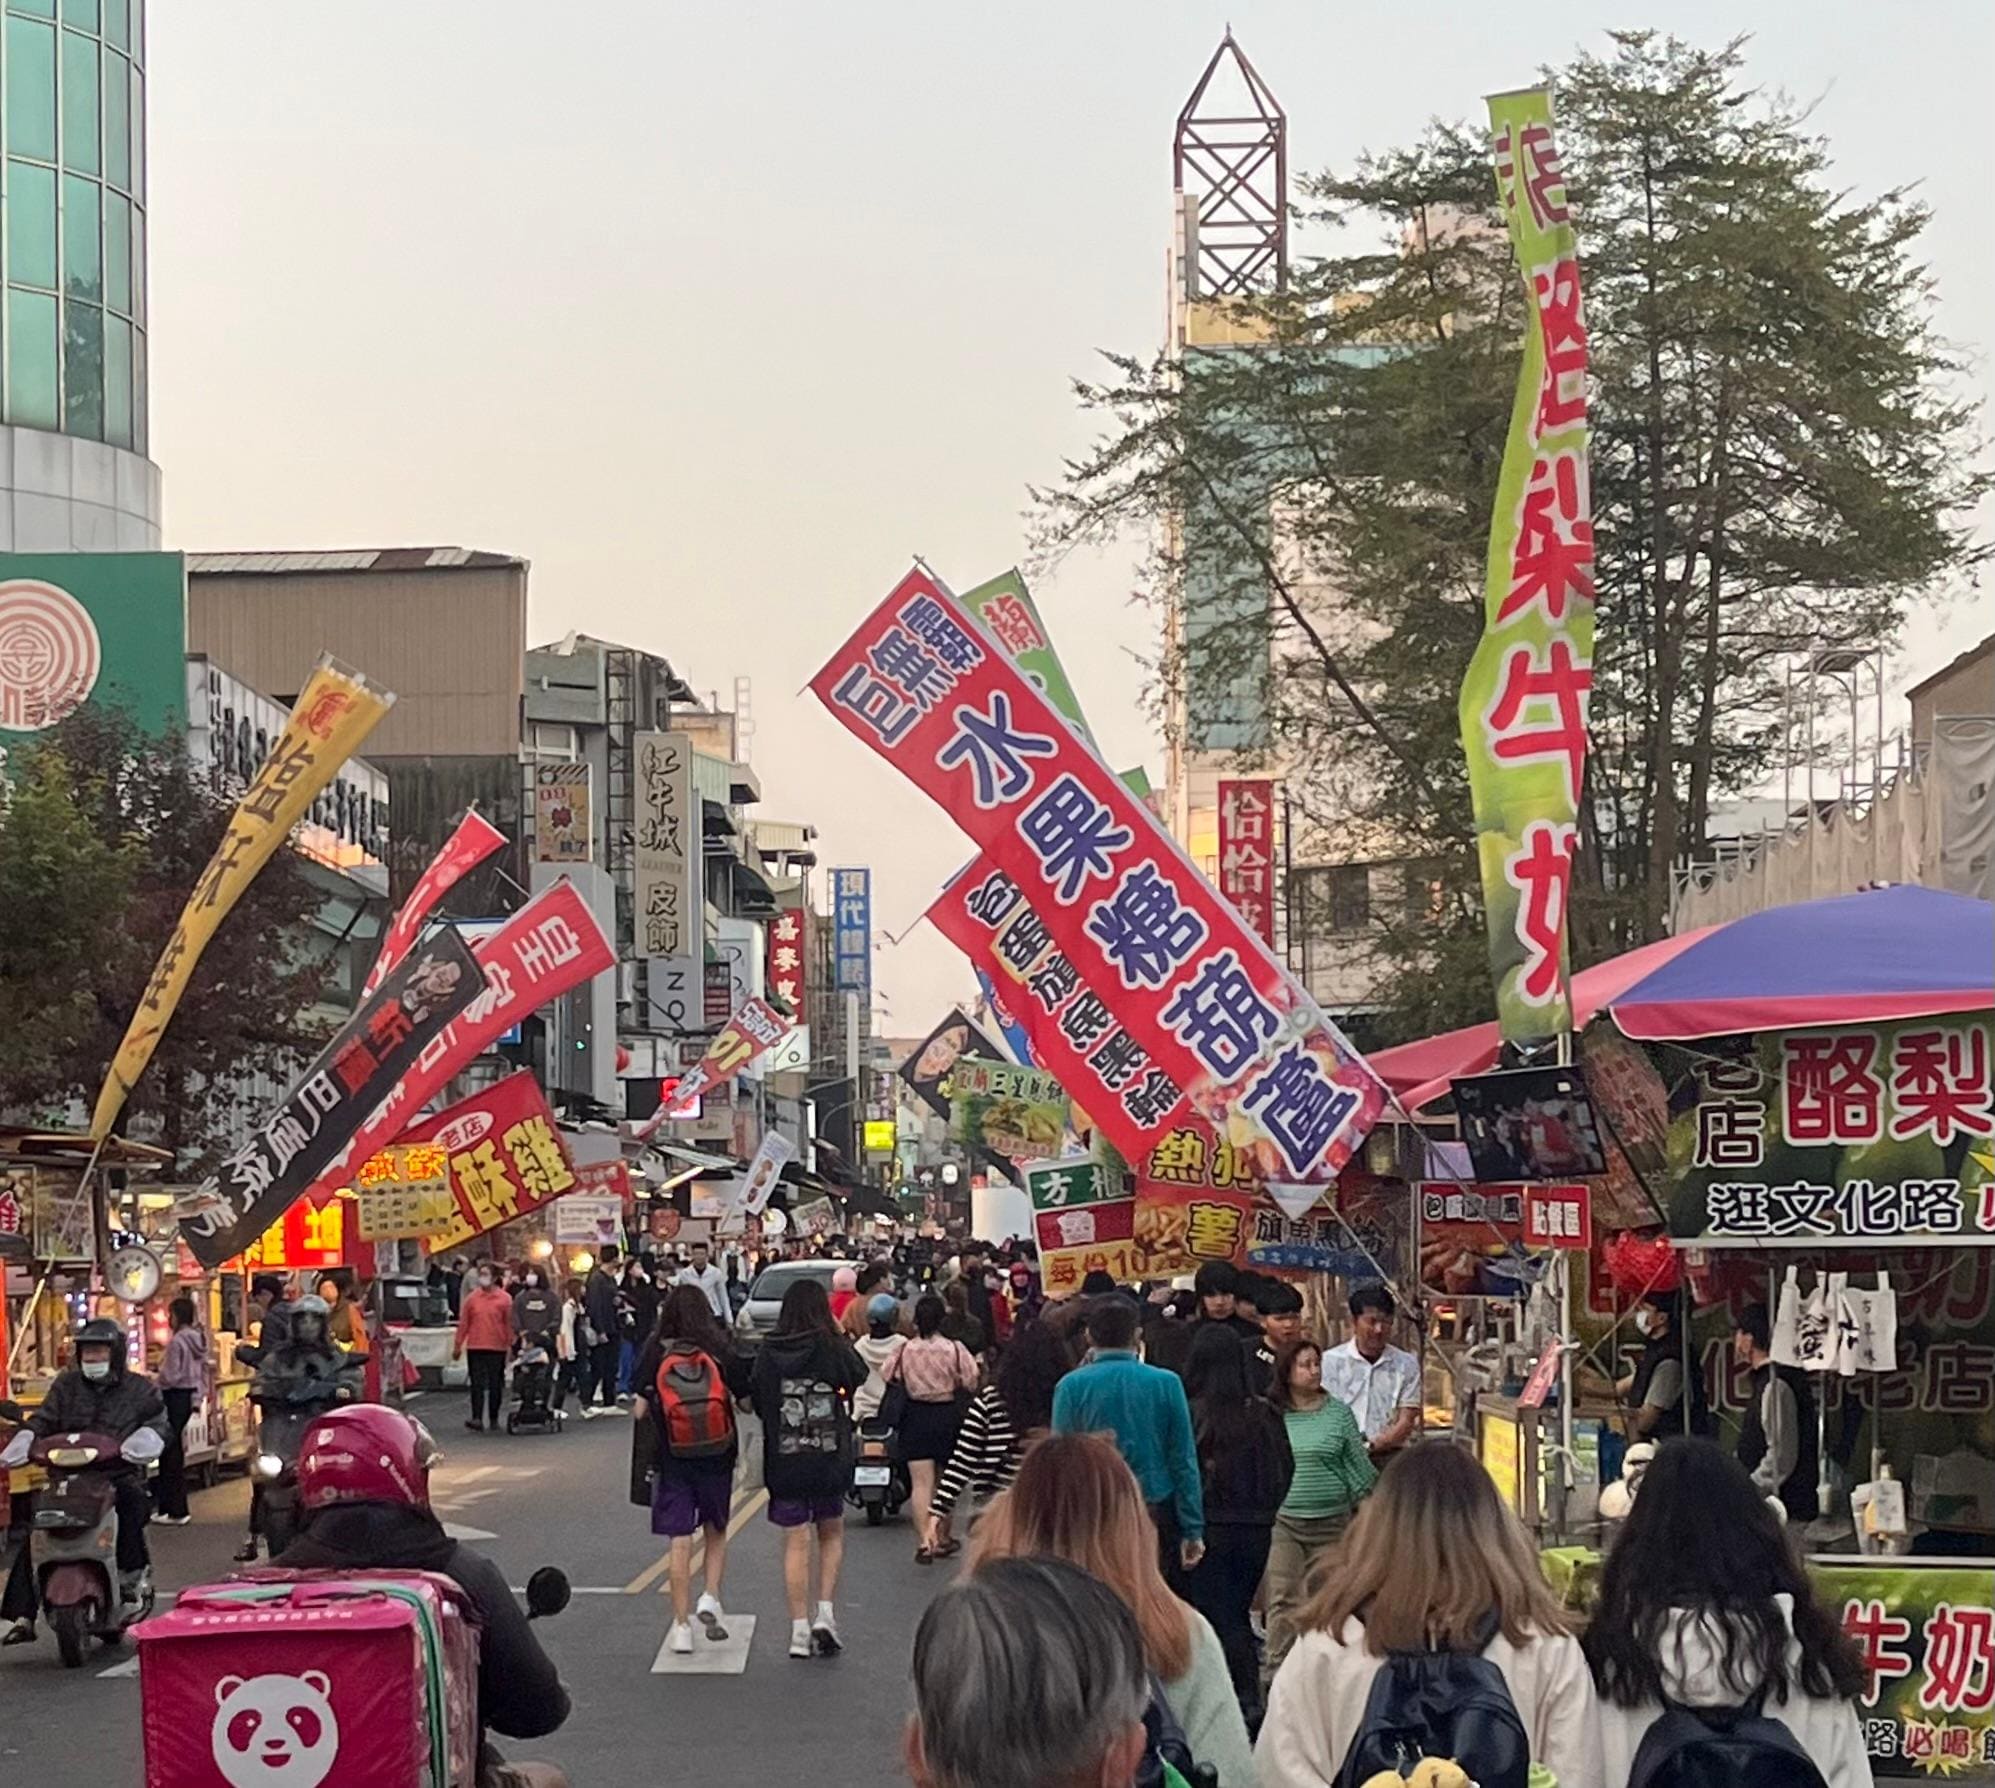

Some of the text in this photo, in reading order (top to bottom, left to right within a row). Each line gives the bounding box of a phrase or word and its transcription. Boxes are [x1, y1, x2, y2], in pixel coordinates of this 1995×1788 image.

[833, 594, 982, 745] 巨無霸
[646, 880, 678, 953] 皮飾
[936, 690, 1362, 1178] 水果糖葫蘆
[440, 1115, 485, 1150] 老店
[1781, 1027, 1995, 1145] 酪梨
[1843, 1600, 1995, 1709] 牛奶
